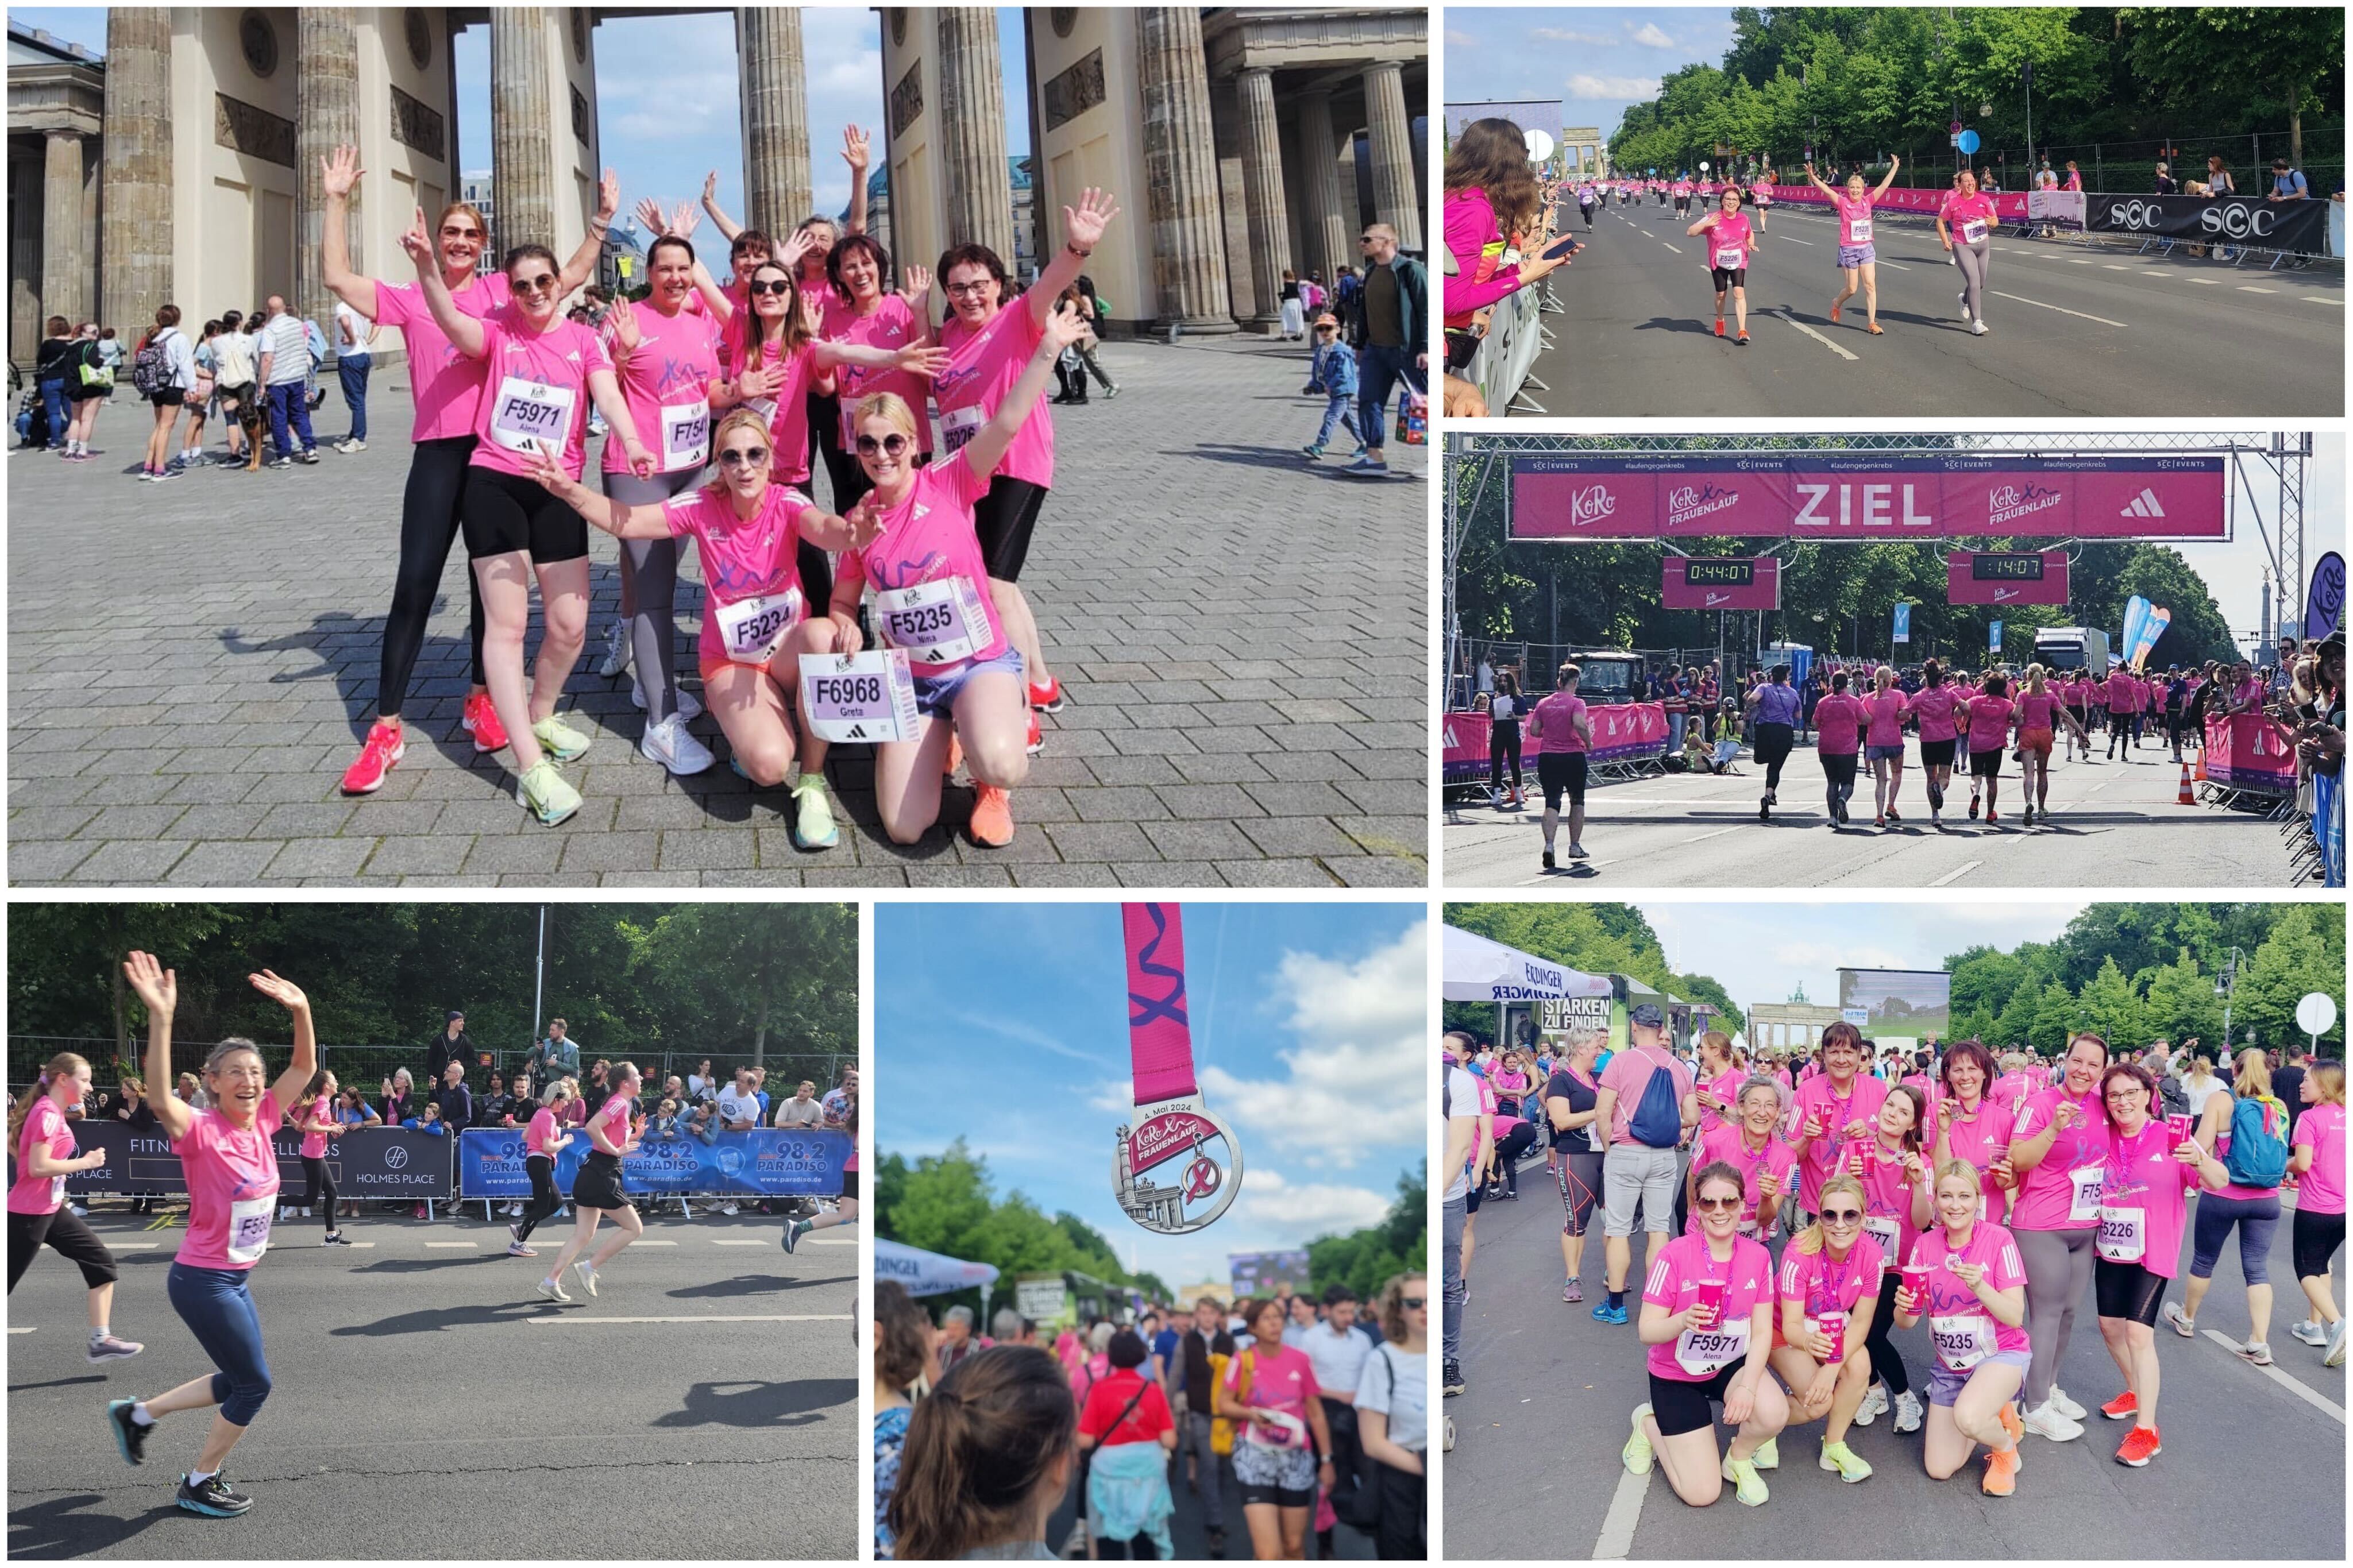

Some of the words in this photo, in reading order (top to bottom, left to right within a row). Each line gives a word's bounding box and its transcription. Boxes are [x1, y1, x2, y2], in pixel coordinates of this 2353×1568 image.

[2111, 199, 2162, 230] SCC
[2201, 203, 2275, 239] SCC
[504, 399, 561, 427] F5971
[519, 424, 540, 434] Alena
[1533, 461, 1546, 470] SCC
[1737, 461, 1750, 469] SCC
[1945, 461, 1959, 469] SCC
[2043, 461, 2106, 469] #laufengegenkrebs
[2157, 460, 2171, 468] SCC
[1571, 485, 1615, 526] KoRo
[1669, 486, 1699, 513] KoRo
[1795, 484, 1931, 526] ZIEL
[1989, 486, 2020, 513] KoRo
[1989, 495, 2061, 525] FRAUENLAUF
[1669, 495, 1738, 526] FRAUENLAUF
[1691, 566, 1748, 579] 0:44:07
[737, 607, 790, 644] F5234
[890, 604, 952, 635] F5235
[918, 635, 936, 644] Nina
[817, 677, 880, 704] F6968
[840, 707, 864, 716] Greta
[1525, 963, 1563, 990] ERDINGER
[1544, 1015, 1560, 1028] ZU
[1153, 1105, 1168, 1116] Mai
[1136, 1126, 1162, 1151] KoRo
[1139, 1123, 1198, 1161] FRAUENLAUF
[642, 1141, 694, 1159] 98.2
[777, 1142, 826, 1160] 98.2
[76, 1169, 112, 1179] PLACE
[623, 1160, 699, 1172] PARADISO
[757, 1160, 828, 1172] PARADISO
[357, 1174, 400, 1183] HOLMES
[403, 1175, 435, 1184] PLACE
[1688, 1335, 1739, 1351] F5971
[1934, 1332, 1973, 1349] F5235
